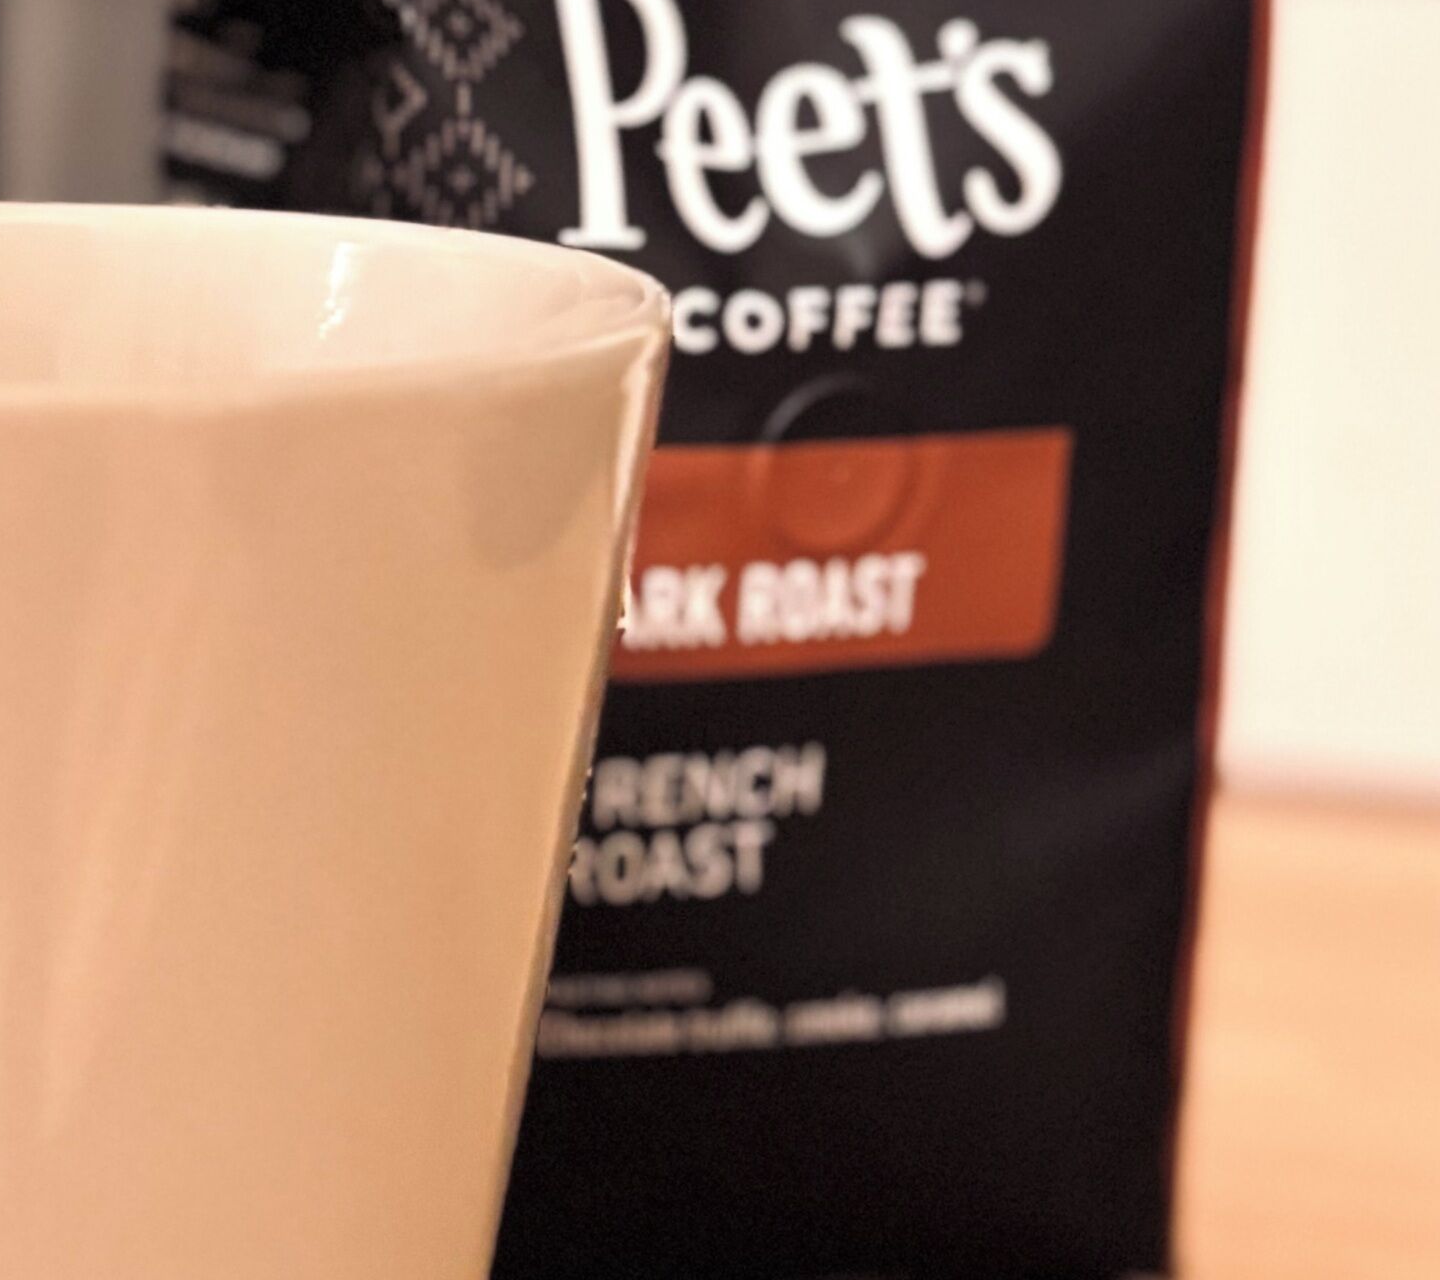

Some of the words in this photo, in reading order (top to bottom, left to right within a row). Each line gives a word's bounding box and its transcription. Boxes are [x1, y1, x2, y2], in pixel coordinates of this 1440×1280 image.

[672, 280, 963, 354] COFFEE
[619, 563, 728, 651] ARK
[736, 551, 926, 646] ROAST
[591, 740, 827, 830] RENCH
